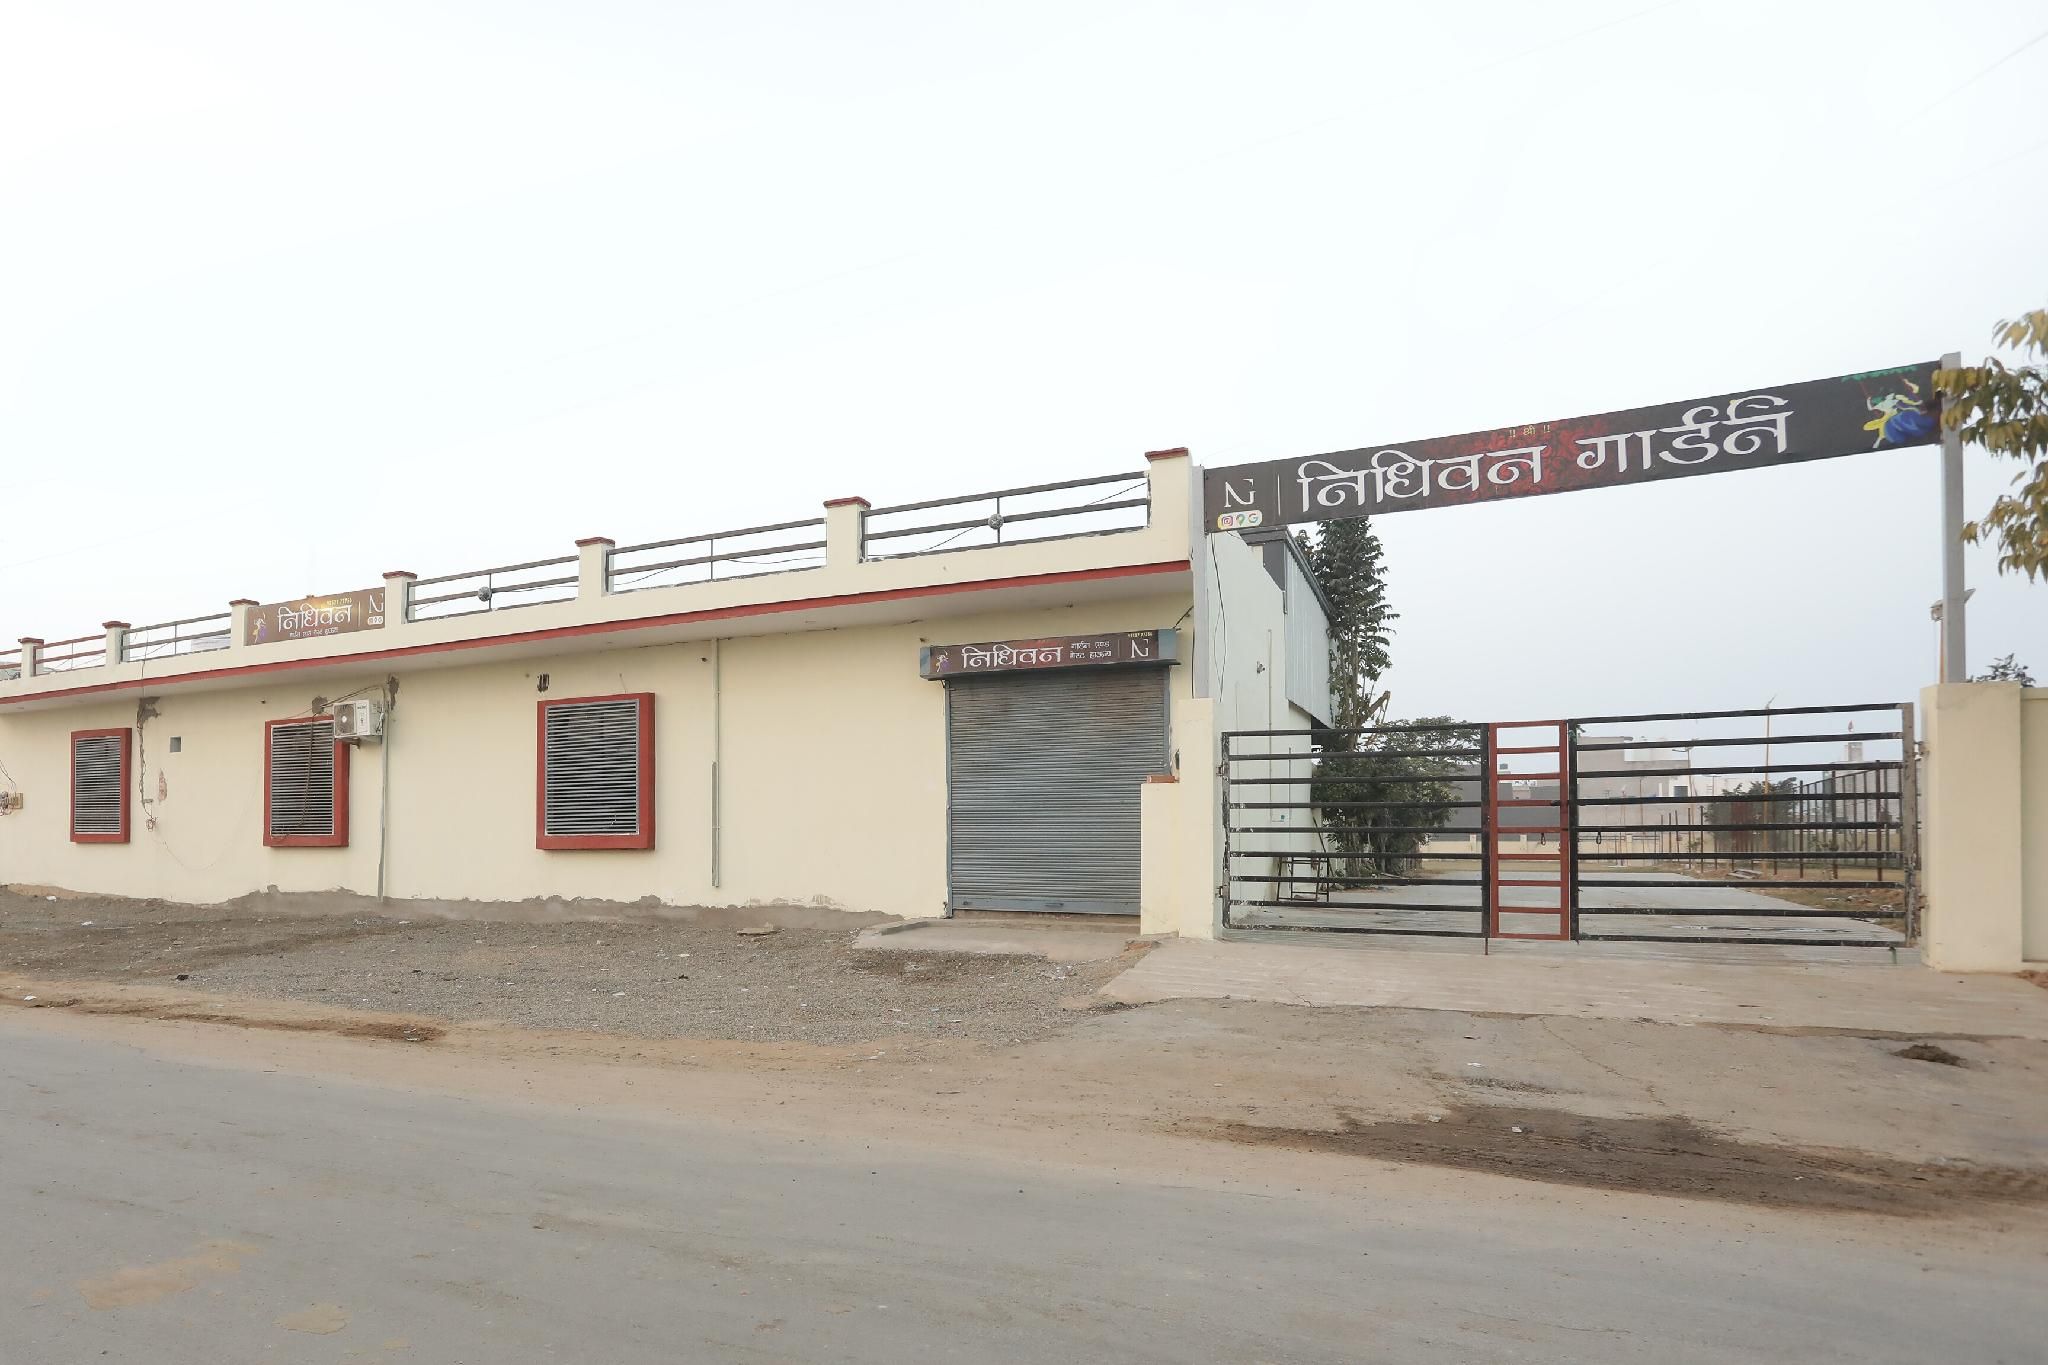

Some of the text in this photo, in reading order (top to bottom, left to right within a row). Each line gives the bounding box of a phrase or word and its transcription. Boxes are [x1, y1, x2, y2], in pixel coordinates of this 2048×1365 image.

[1296, 445, 1548, 513] निधिवन
[277, 603, 353, 633] निधिवन
[961, 643, 1064, 669] निधिवन
